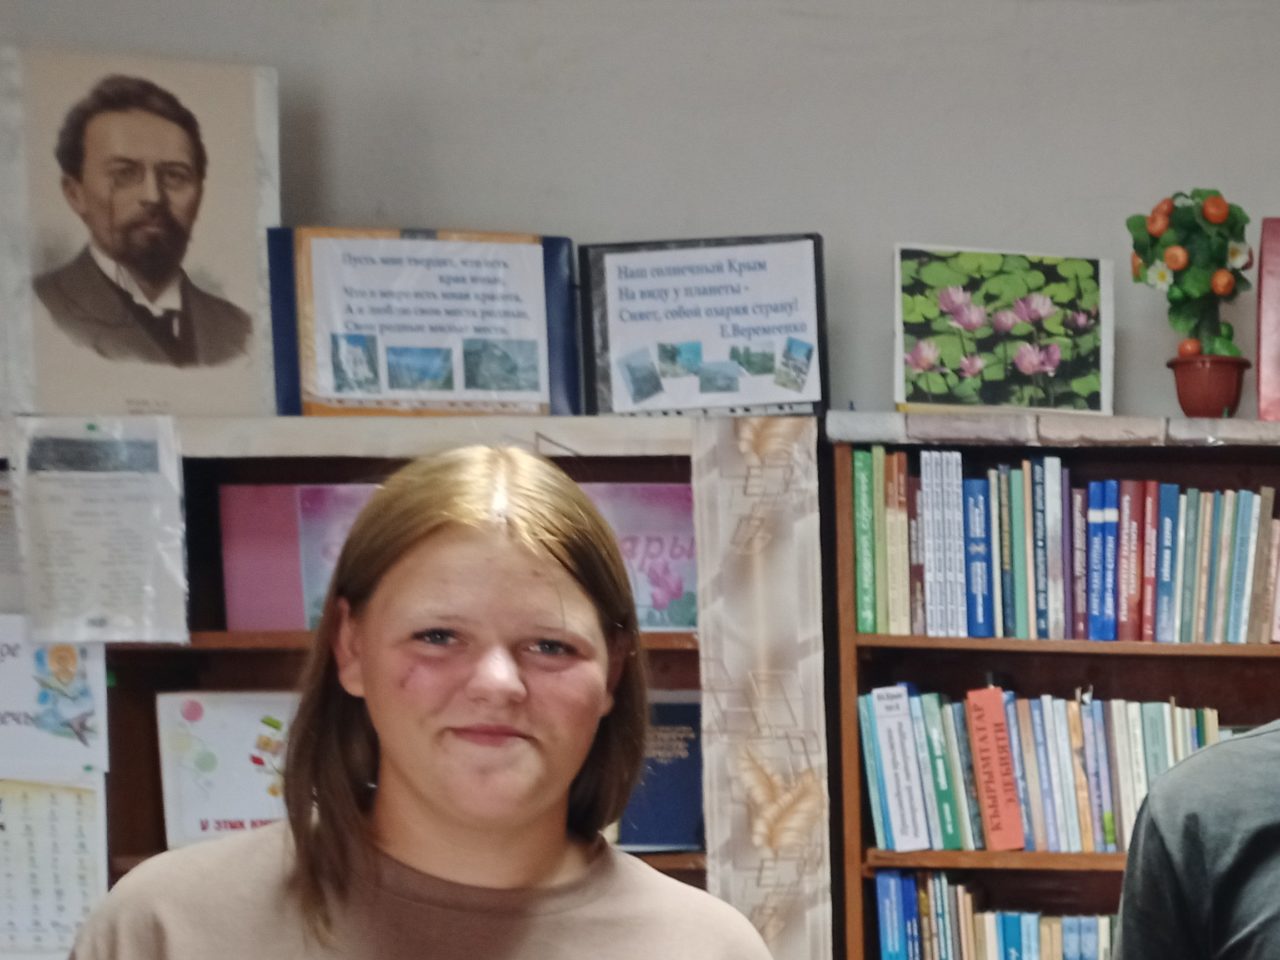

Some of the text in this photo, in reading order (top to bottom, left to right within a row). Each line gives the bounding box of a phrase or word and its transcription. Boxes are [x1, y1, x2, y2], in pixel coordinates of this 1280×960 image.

[617, 259, 767, 280] Наш солнечный Крым
[618, 287, 636, 301] На
[639, 285, 670, 300] виду
[672, 286, 681, 299] у
[683, 282, 742, 298] планеты
[751, 297, 799, 317] страну!
[972, 703, 1002, 832] КЪЫРЫМТАТАР
